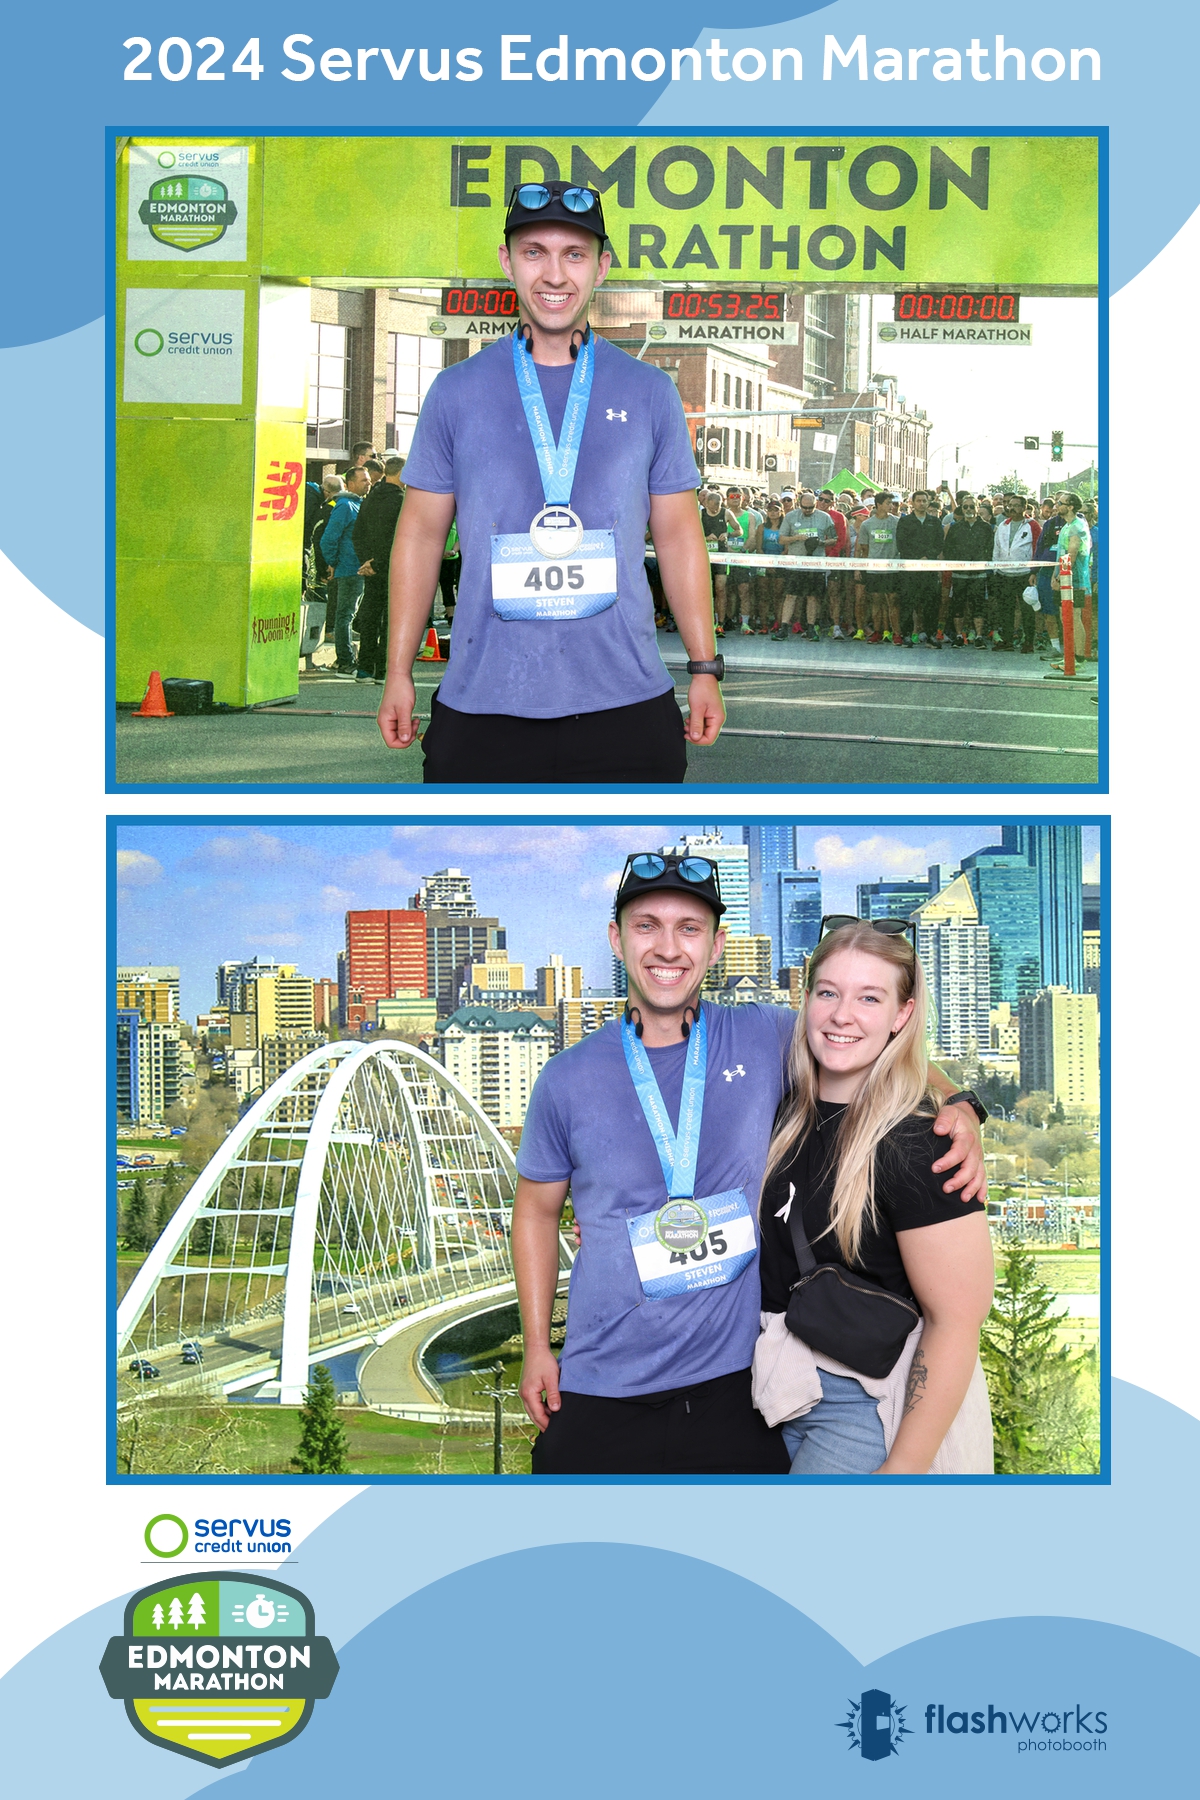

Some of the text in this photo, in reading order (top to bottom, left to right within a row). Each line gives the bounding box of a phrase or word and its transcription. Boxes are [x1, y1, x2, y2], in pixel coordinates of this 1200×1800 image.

[178, 152, 219, 161] servus
[450, 145, 990, 211] EDMONTON
[149, 202, 227, 214] EDMONTON
[160, 214, 215, 222] MARATHON
[606, 223, 907, 272] RATHON
[465, 321, 518, 335] ARMY
[678, 324, 785, 340] MARATHON
[900, 328, 939, 340] HALF
[942, 328, 1031, 341] MARATHON
[168, 331, 233, 345] servus
[168, 345, 233, 355] credit union
[579, 350, 590, 384] MARATHON
[523, 367, 532, 387] union
[532, 405, 547, 442] MARATHON
[561, 402, 580, 467] servus credit union
[523, 564, 585, 592] 405
[535, 596, 575, 608] STEVEN
[535, 609, 577, 617] MARATHON
[628, 1035, 639, 1055] credit
[634, 1054, 645, 1075] union
[692, 1028, 702, 1066] MARATHON
[647, 1094, 666, 1133] MARATHON
[682, 1087, 696, 1158] servus credit union
[684, 1263, 723, 1281] STEVEN
[686, 1275, 727, 1290] MARATHON
